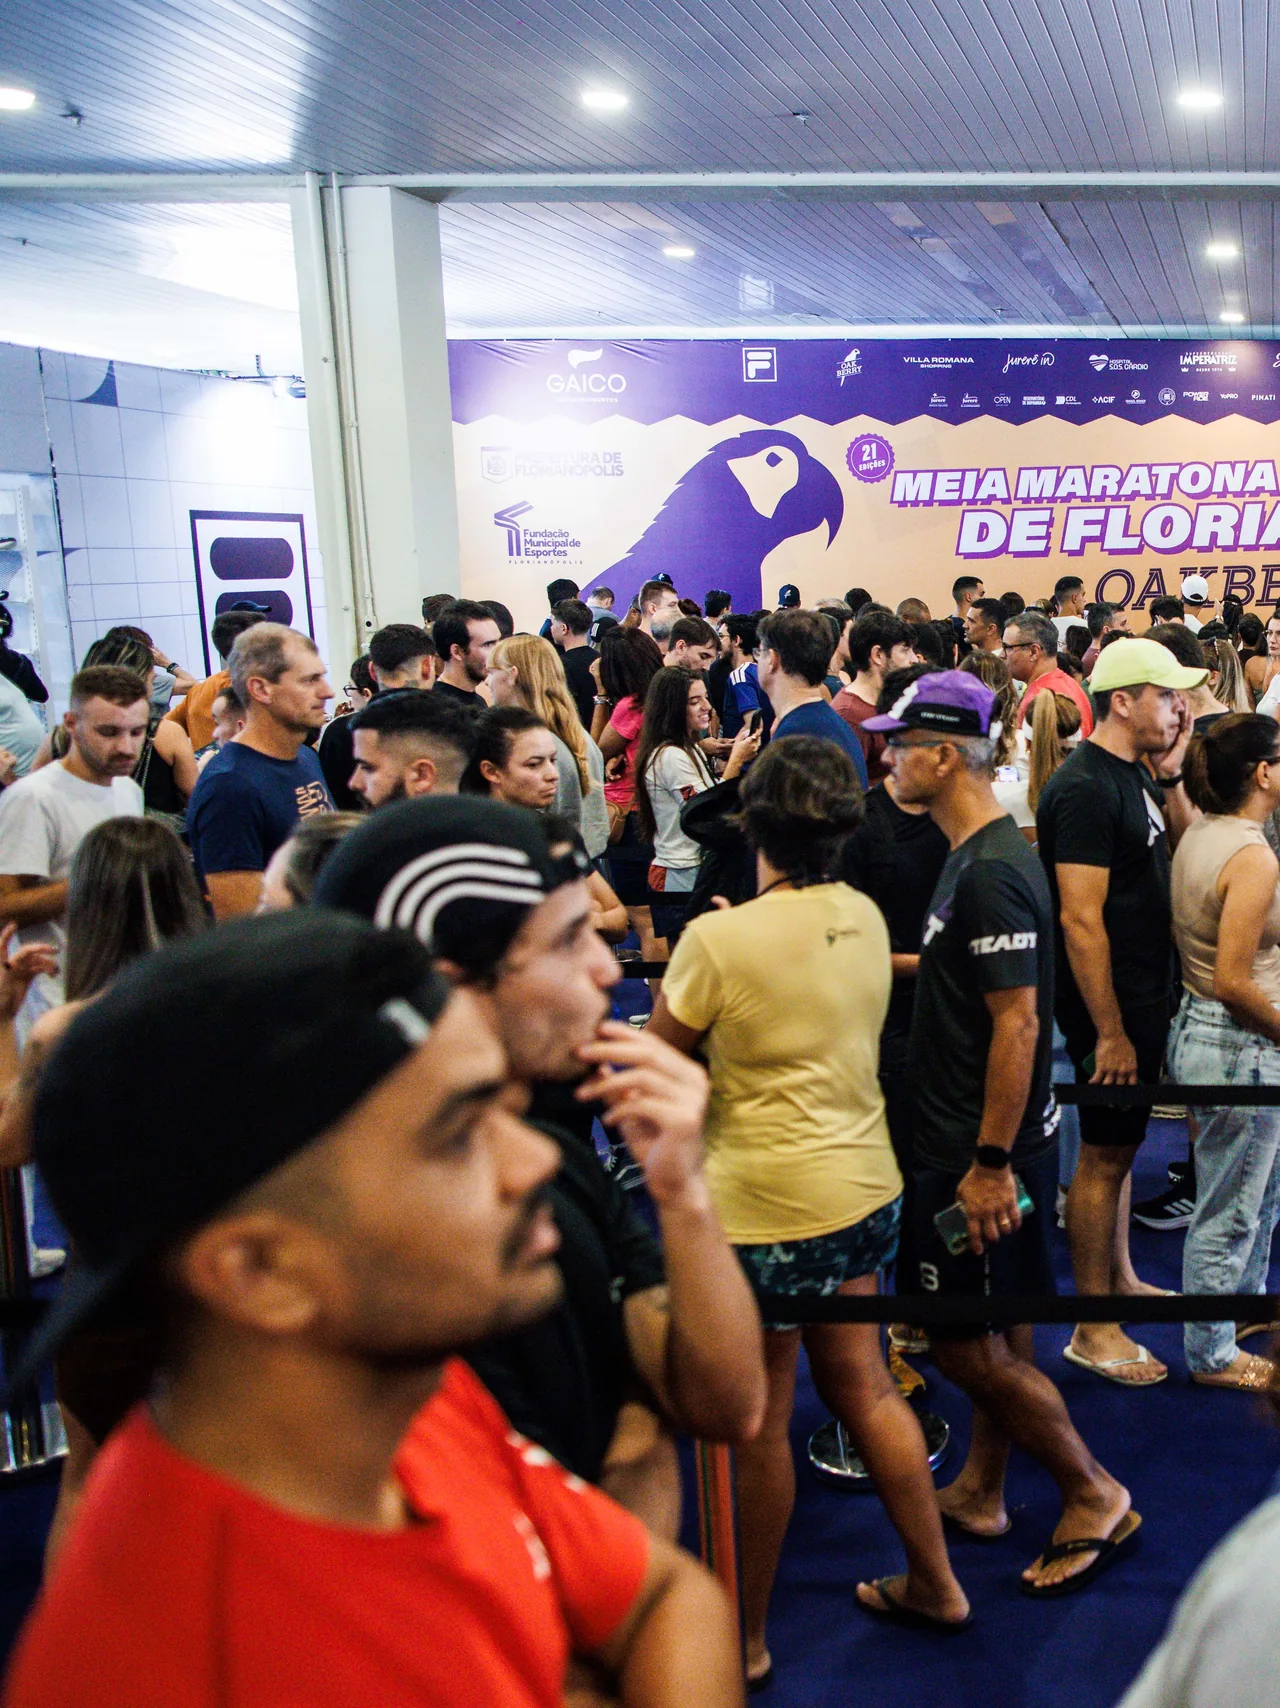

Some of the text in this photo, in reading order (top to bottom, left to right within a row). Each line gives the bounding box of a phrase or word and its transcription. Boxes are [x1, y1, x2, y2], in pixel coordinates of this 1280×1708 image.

[931, 356, 974, 364] ROMANA
[1180, 355, 1237, 365] IMPERATRIZ
[546, 373, 627, 394] GAICO
[603, 452, 622, 464] DE
[862, 443, 877, 462] 21
[892, 468, 1011, 504] MEIA
[1014, 460, 1280, 500] MARATONA
[956, 507, 1055, 558] DE
[524, 539, 581, 550] Municipal de
[524, 548, 568, 559] Esportes
[968, 932, 1038, 955] TEADY
